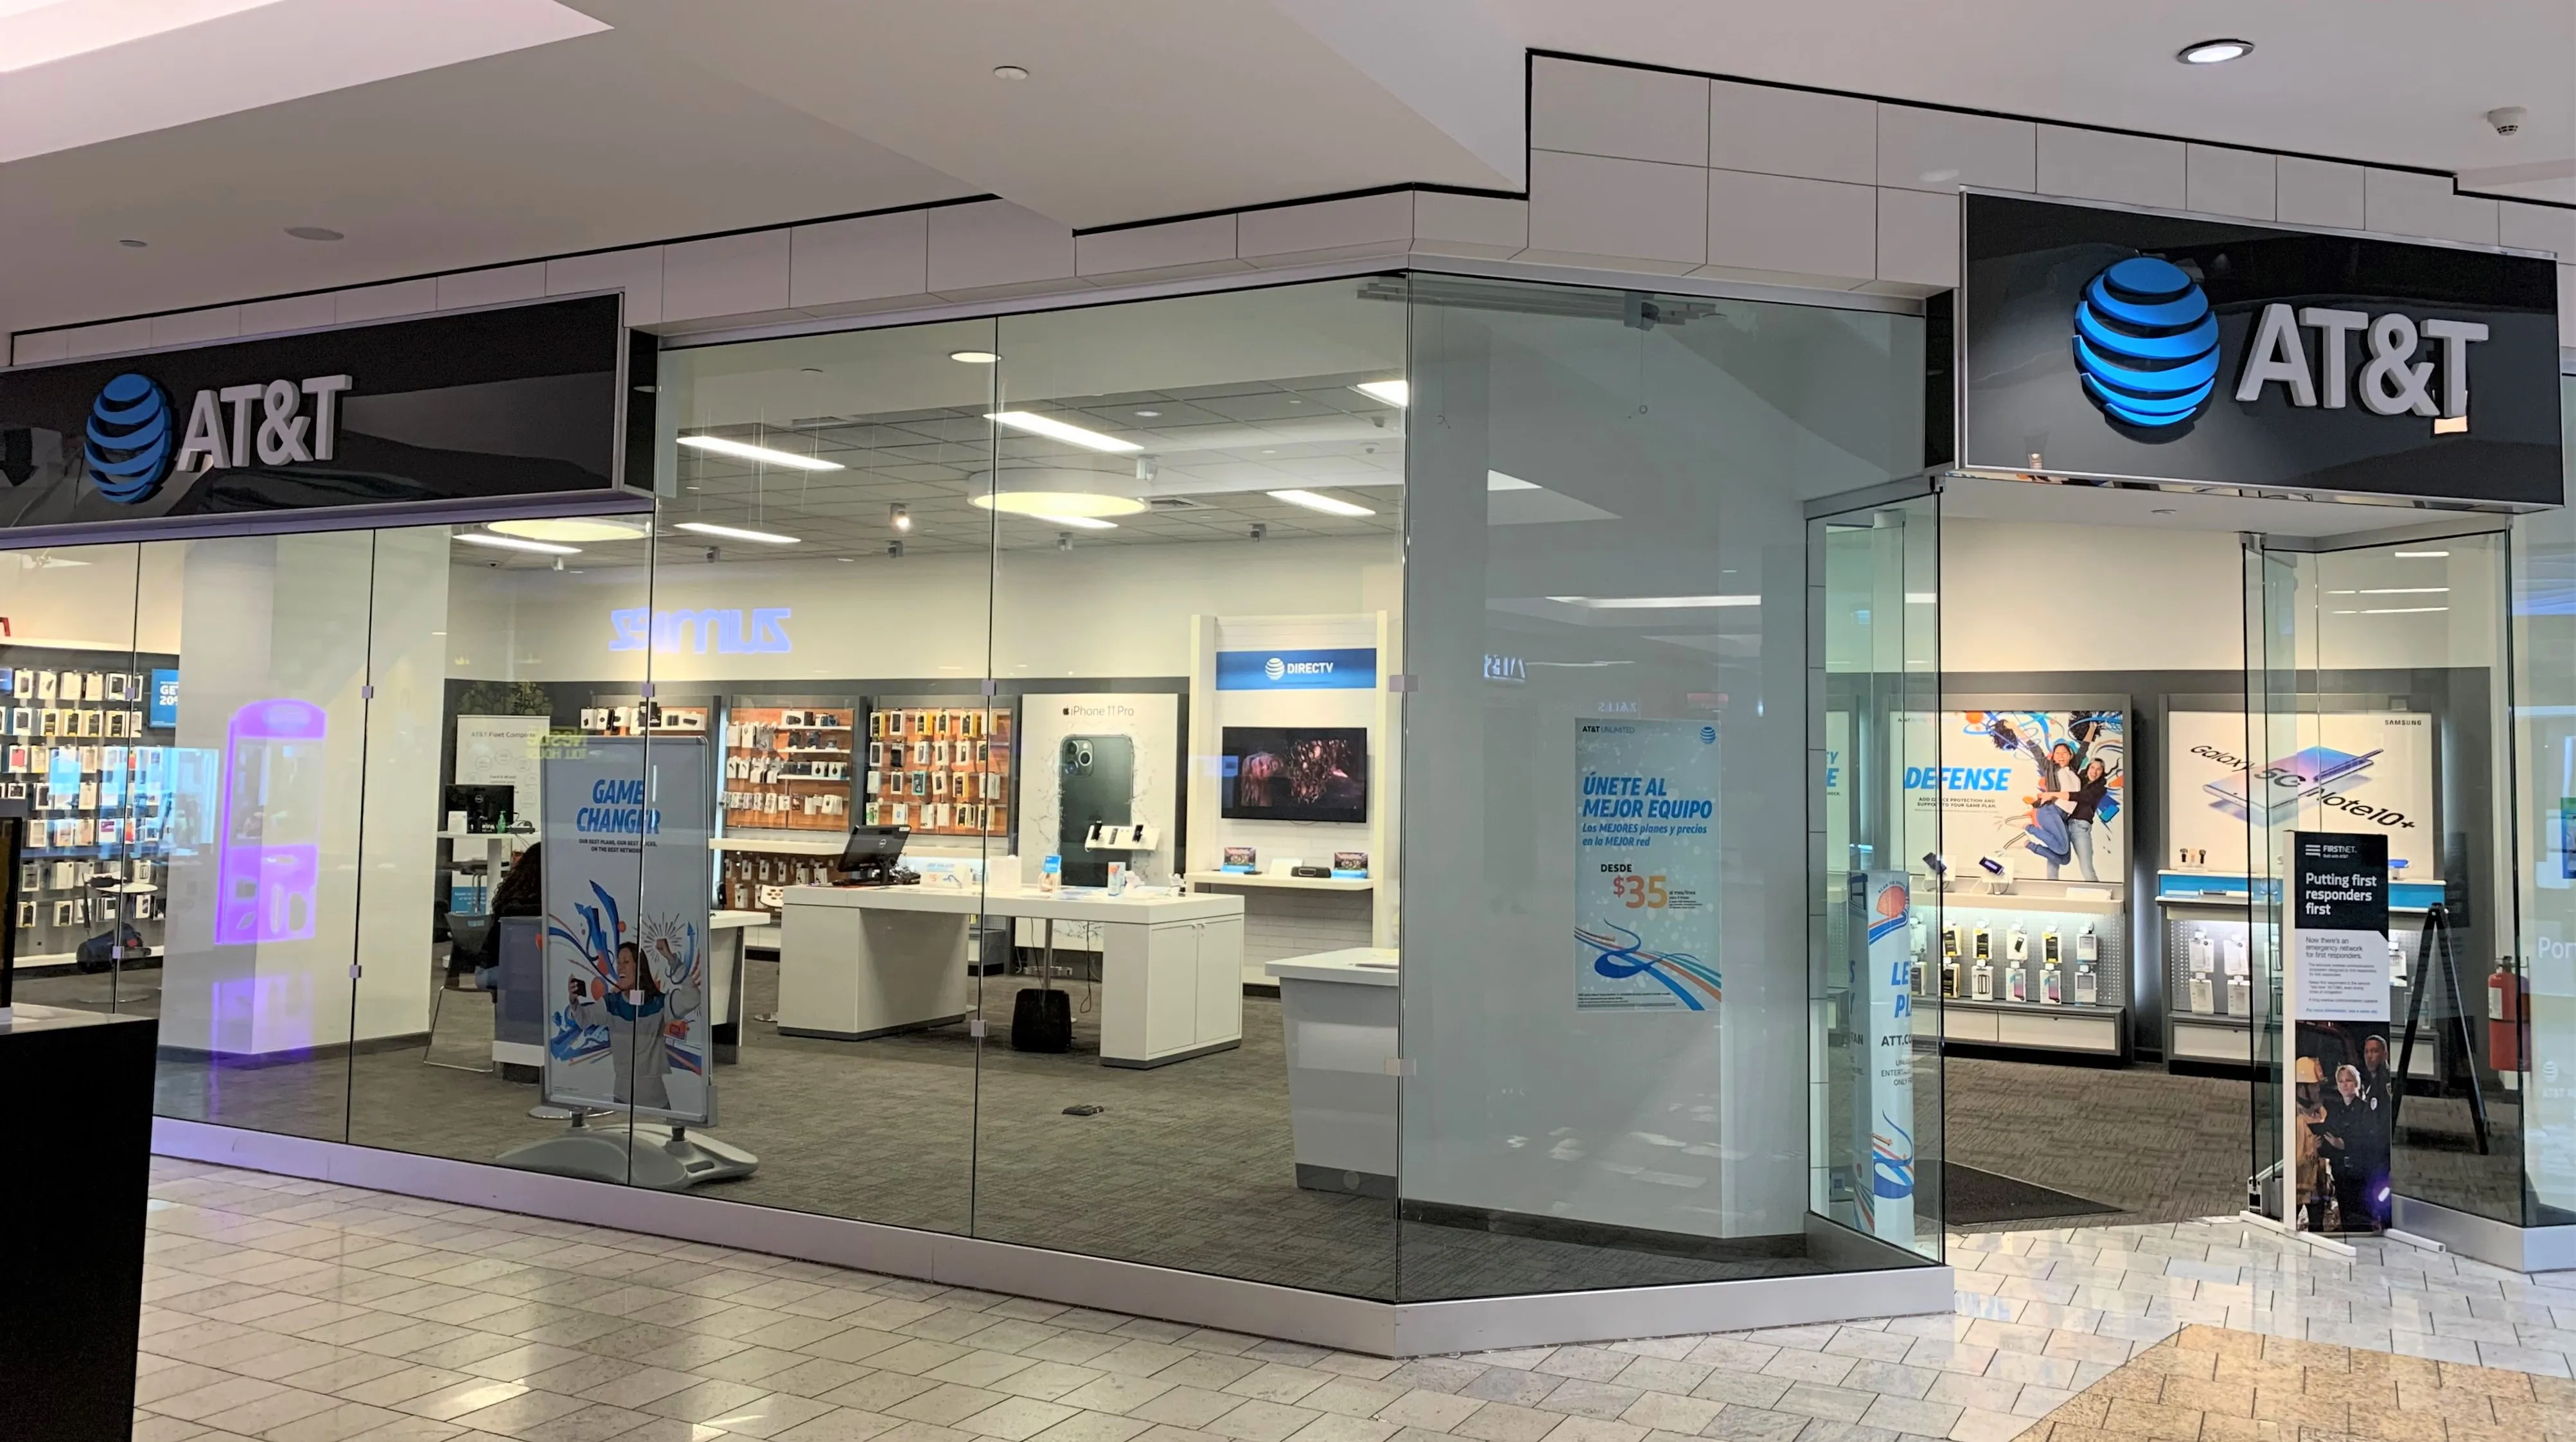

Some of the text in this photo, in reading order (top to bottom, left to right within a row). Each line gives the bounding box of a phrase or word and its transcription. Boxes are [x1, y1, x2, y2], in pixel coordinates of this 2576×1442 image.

[2236, 303, 2489, 418] AT&T
[177, 374, 353, 472] AT&T
[1287, 662, 1334, 674] DIRECTV
[1070, 706, 1134, 717] iPhone 11 Pro
[2191, 745, 2256, 772] Galaxy
[1583, 771, 1667, 796] ÚNETE AL
[1905, 767, 2011, 791] DEFENSE
[2254, 767, 2306, 787] 5G
[592, 779, 644, 805] GAME
[1582, 799, 1713, 819] MEJOR EQUIPO
[2306, 788, 2415, 828] Note10+
[1582, 823, 1707, 836] Los MEJORES planes y precios
[1594, 837, 1603, 846] la
[1605, 837, 1634, 846] MEJOR
[1636, 837, 1650, 846] red
[1601, 864, 1632, 872] DESDE
[2306, 873, 2377, 888] Putting first
[1613, 875, 1668, 909] $35
[2306, 889, 2372, 902] responders
[2305, 902, 2331, 915] first
[1891, 962, 1910, 986] LE
